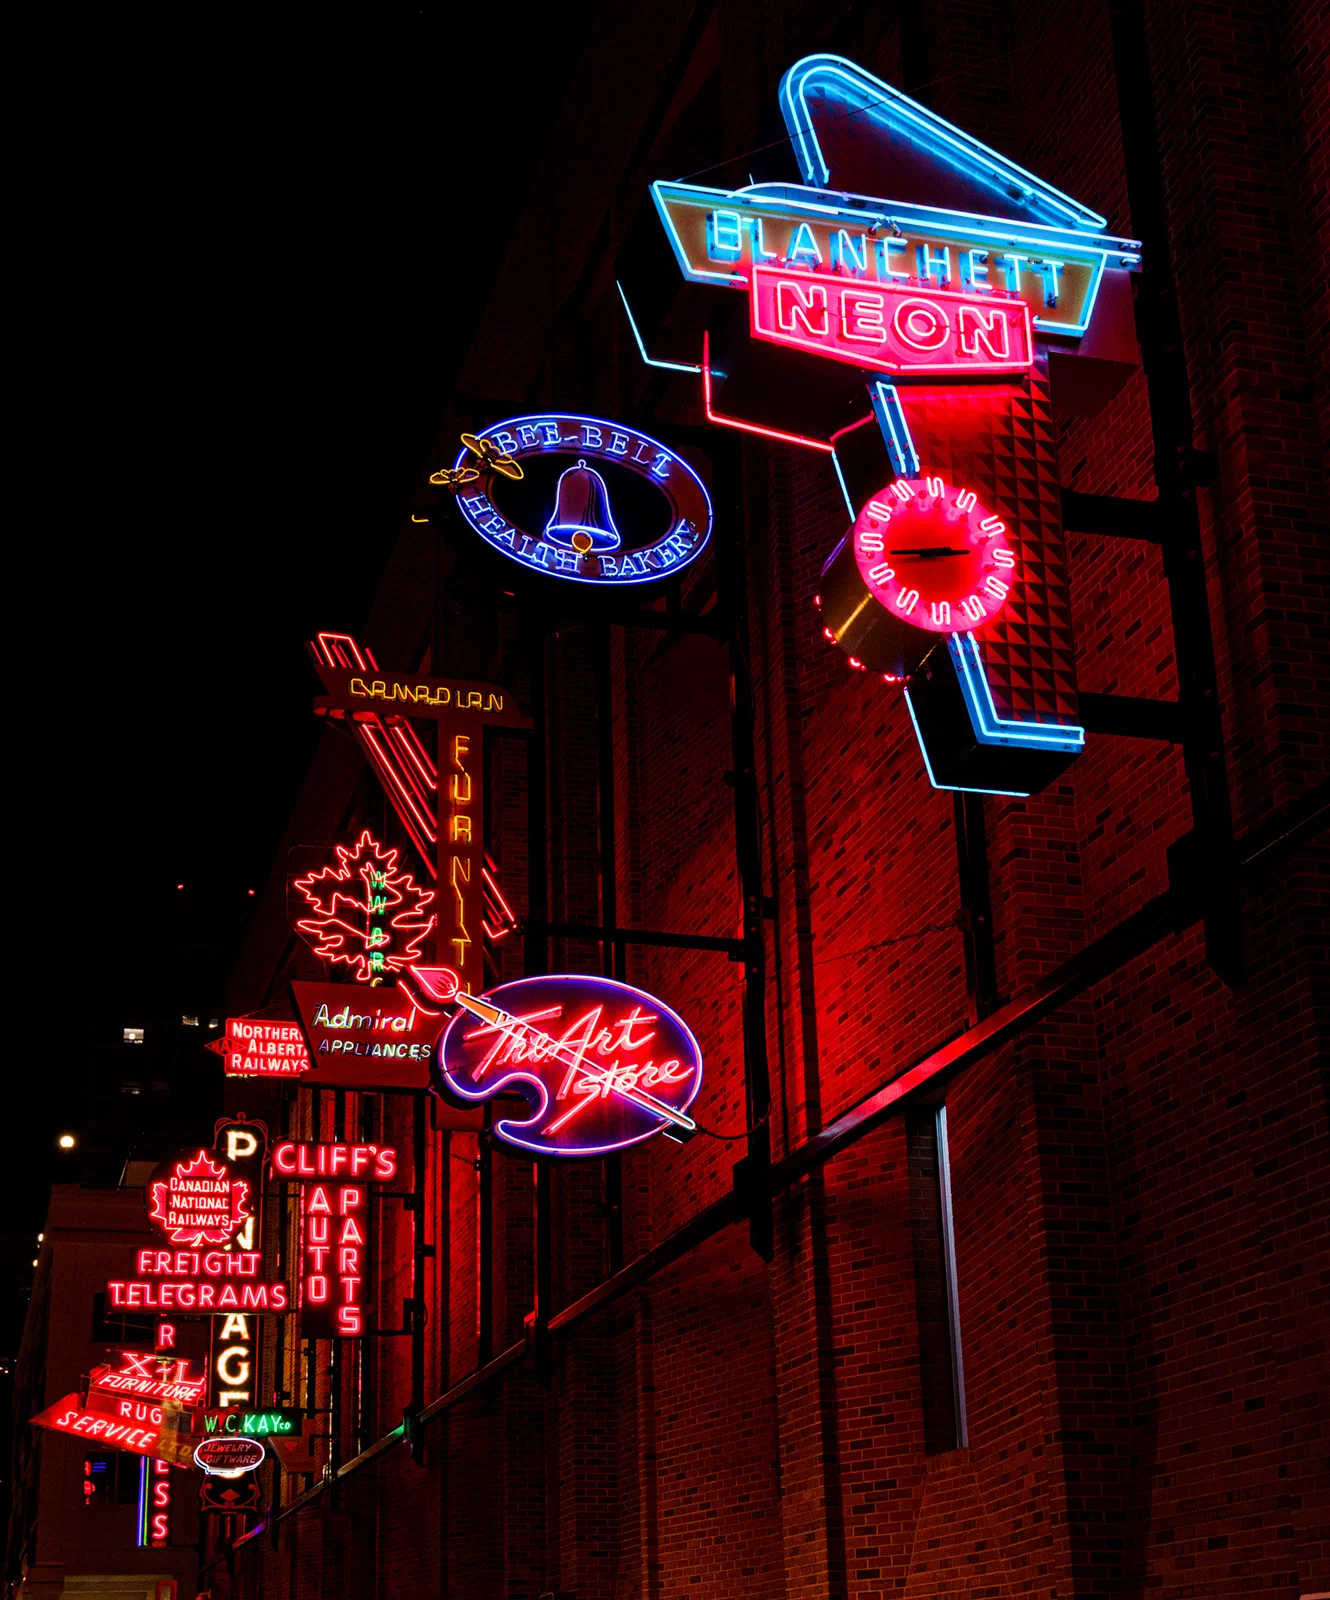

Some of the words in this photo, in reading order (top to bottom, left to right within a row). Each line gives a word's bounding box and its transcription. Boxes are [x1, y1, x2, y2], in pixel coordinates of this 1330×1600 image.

[709, 209, 1066, 307] BLANCHETT
[775, 280, 1010, 359] NEON
[491, 421, 673, 478] BEE-BELL
[461, 492, 583, 575] HEALTH
[597, 518, 700, 577] BAKERY
[349, 677, 504, 711] CANADIAN
[452, 734, 473, 995] FURNIT
[312, 1003, 417, 1032] Admiral
[231, 1053, 309, 1073] RAILWAYS
[318, 1037, 432, 1060] APPLIANCES
[462, 1004, 563, 1081] The
[551, 1003, 659, 1099] Art
[276, 1145, 396, 1177] CLIFF'S
[169, 1177, 230, 1193] CANADIAN
[171, 1196, 230, 1210] NATIONAL
[169, 1213, 230, 1227] RAILWAYS
[309, 1187, 332, 1302] AUTO
[138, 1250, 261, 1276] FREIGHT
[340, 1189, 363, 1334] PARTS
[109, 1282, 287, 1309] TELEGRAMS
[98, 1374, 202, 1402] FURNITURE
[120, 1401, 163, 1425] RUG
[56, 1410, 158, 1449] SERVICE
[203, 1443, 253, 1453] JEWELRY
[205, 1454, 258, 1464] GIFTWARE
